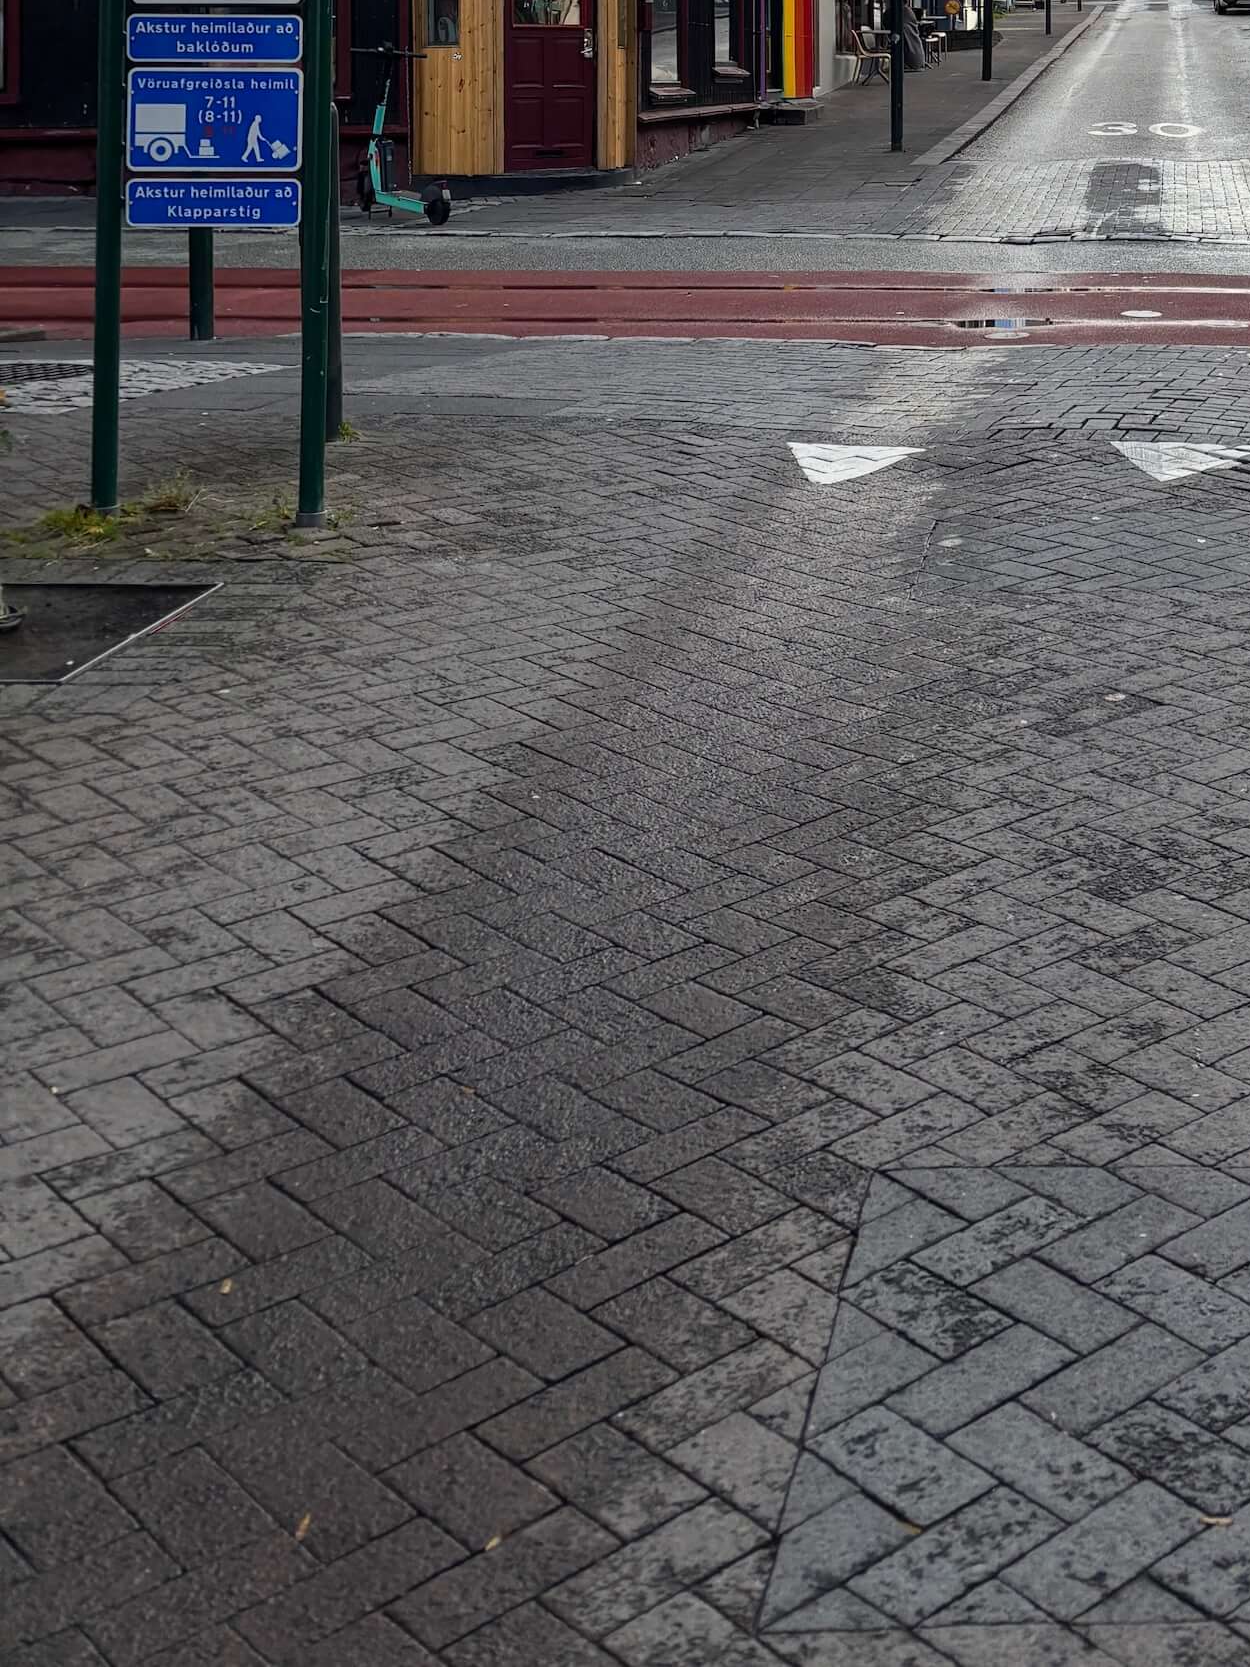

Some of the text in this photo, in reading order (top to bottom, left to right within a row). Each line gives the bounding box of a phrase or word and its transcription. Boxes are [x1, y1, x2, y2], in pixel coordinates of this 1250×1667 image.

[135, 22, 294, 34] Akstur heimilaður að
[176, 41, 254, 53] baklóðum
[137, 78, 294, 91] Vöruafgreiðsla heimil
[204, 96, 236, 109] 7-11
[198, 110, 242, 124] (8-11)
[135, 186, 293, 198] Akstur heimilaður að
